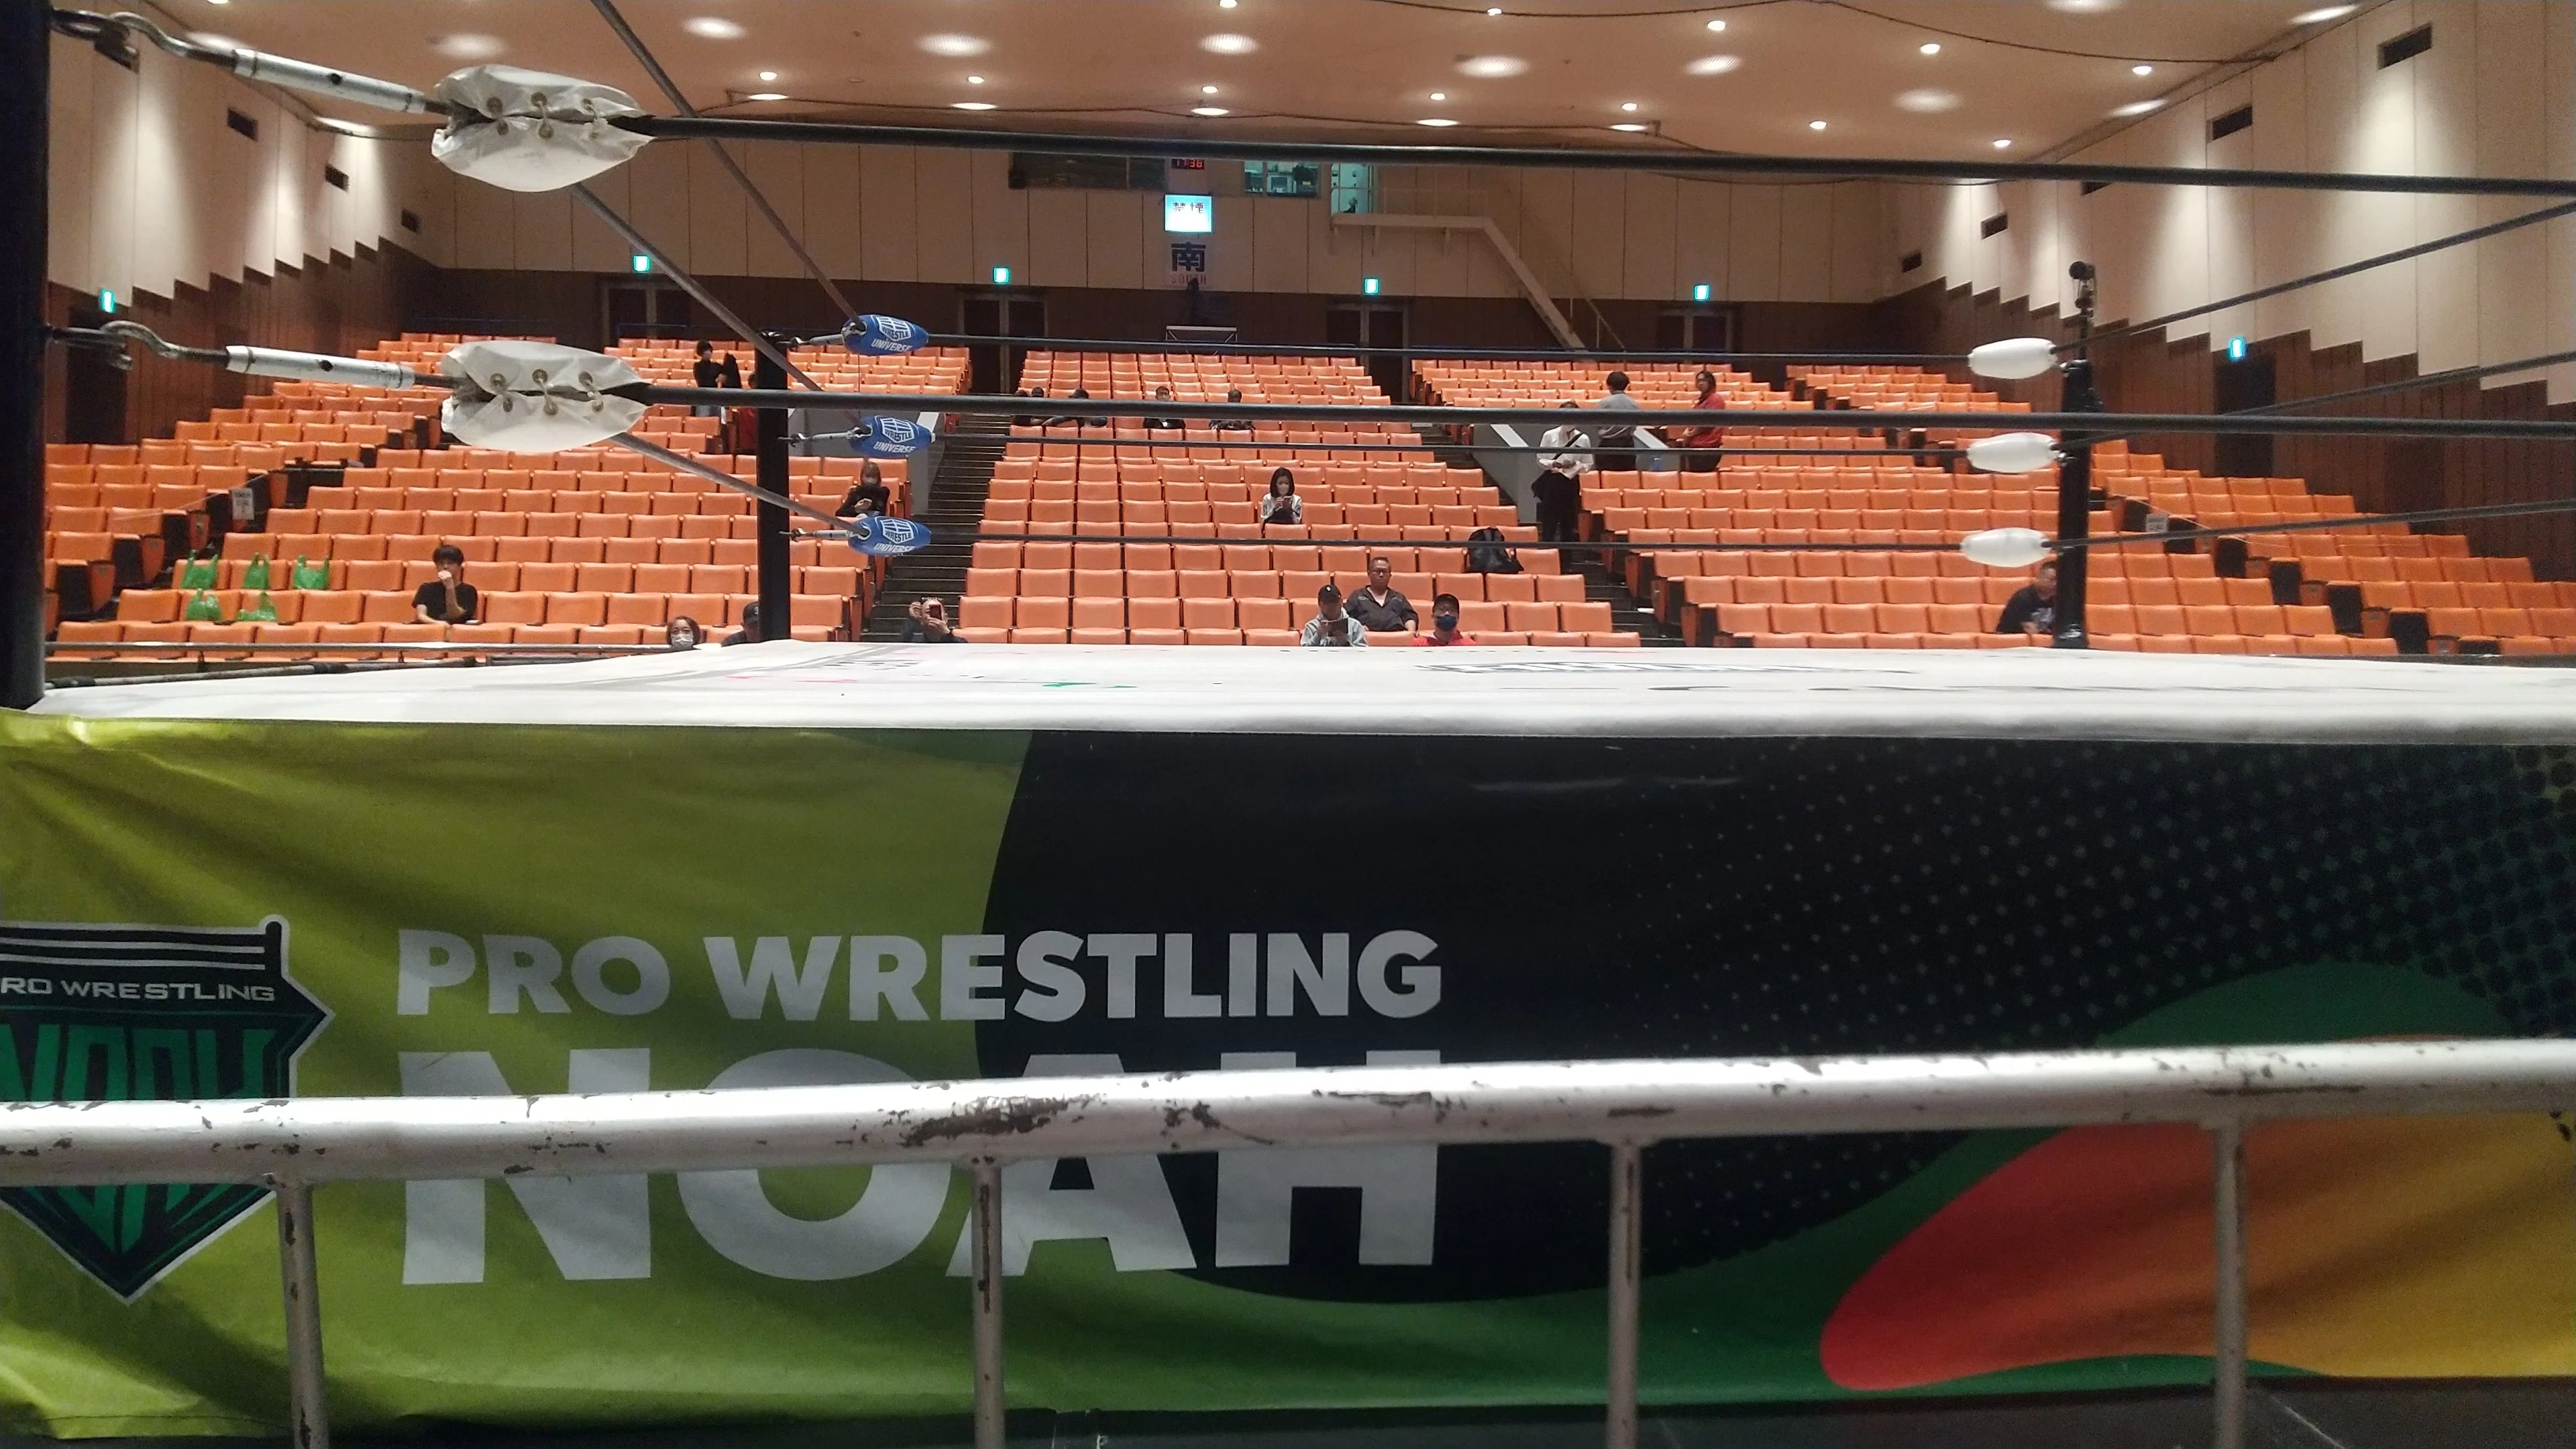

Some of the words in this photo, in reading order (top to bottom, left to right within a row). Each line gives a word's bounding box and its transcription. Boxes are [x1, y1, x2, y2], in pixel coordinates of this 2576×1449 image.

[1171, 241, 1206, 272] 南
[1171, 273, 1207, 285] SOUH
[881, 325, 910, 339] WRESTLE
[883, 428, 912, 441] WRESTLE
[884, 529, 912, 541] WRESTLE
[398, 930, 669, 1016] PRO
[704, 930, 1442, 1022] WRESTLING
[0, 976, 52, 995] RO
[60, 979, 276, 1002] WRESTLING
[400, 1048, 1441, 1284] NOAH
